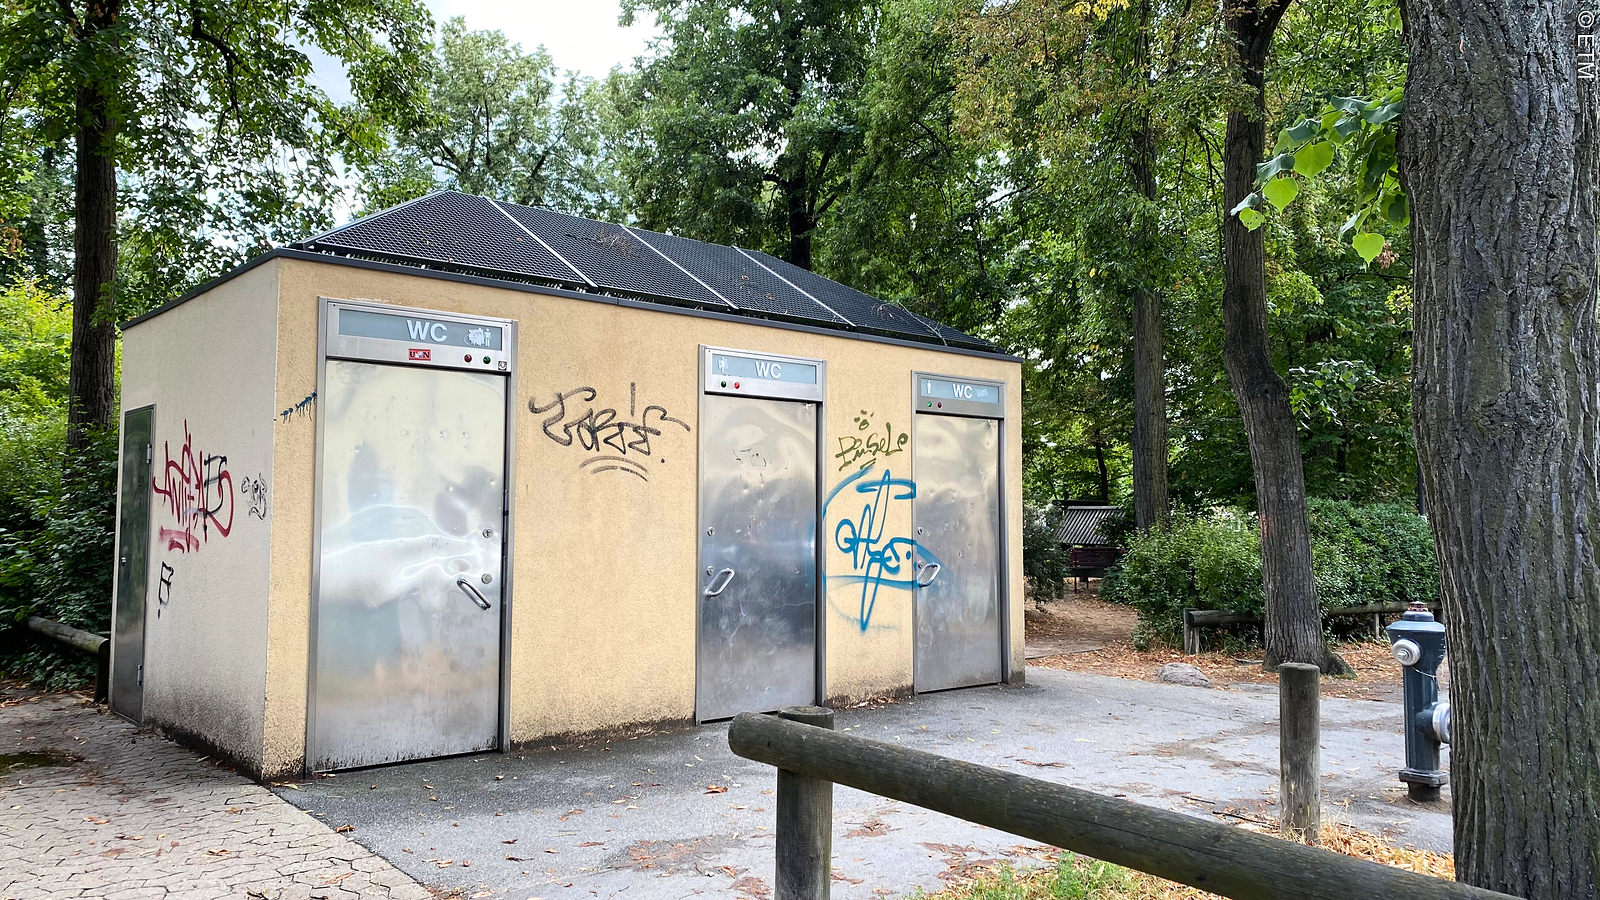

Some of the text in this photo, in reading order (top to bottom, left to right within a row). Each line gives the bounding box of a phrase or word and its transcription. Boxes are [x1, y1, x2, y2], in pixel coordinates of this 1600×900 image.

[406, 319, 448, 342] WC
[755, 361, 782, 378] WC
[952, 383, 973, 399] WC
